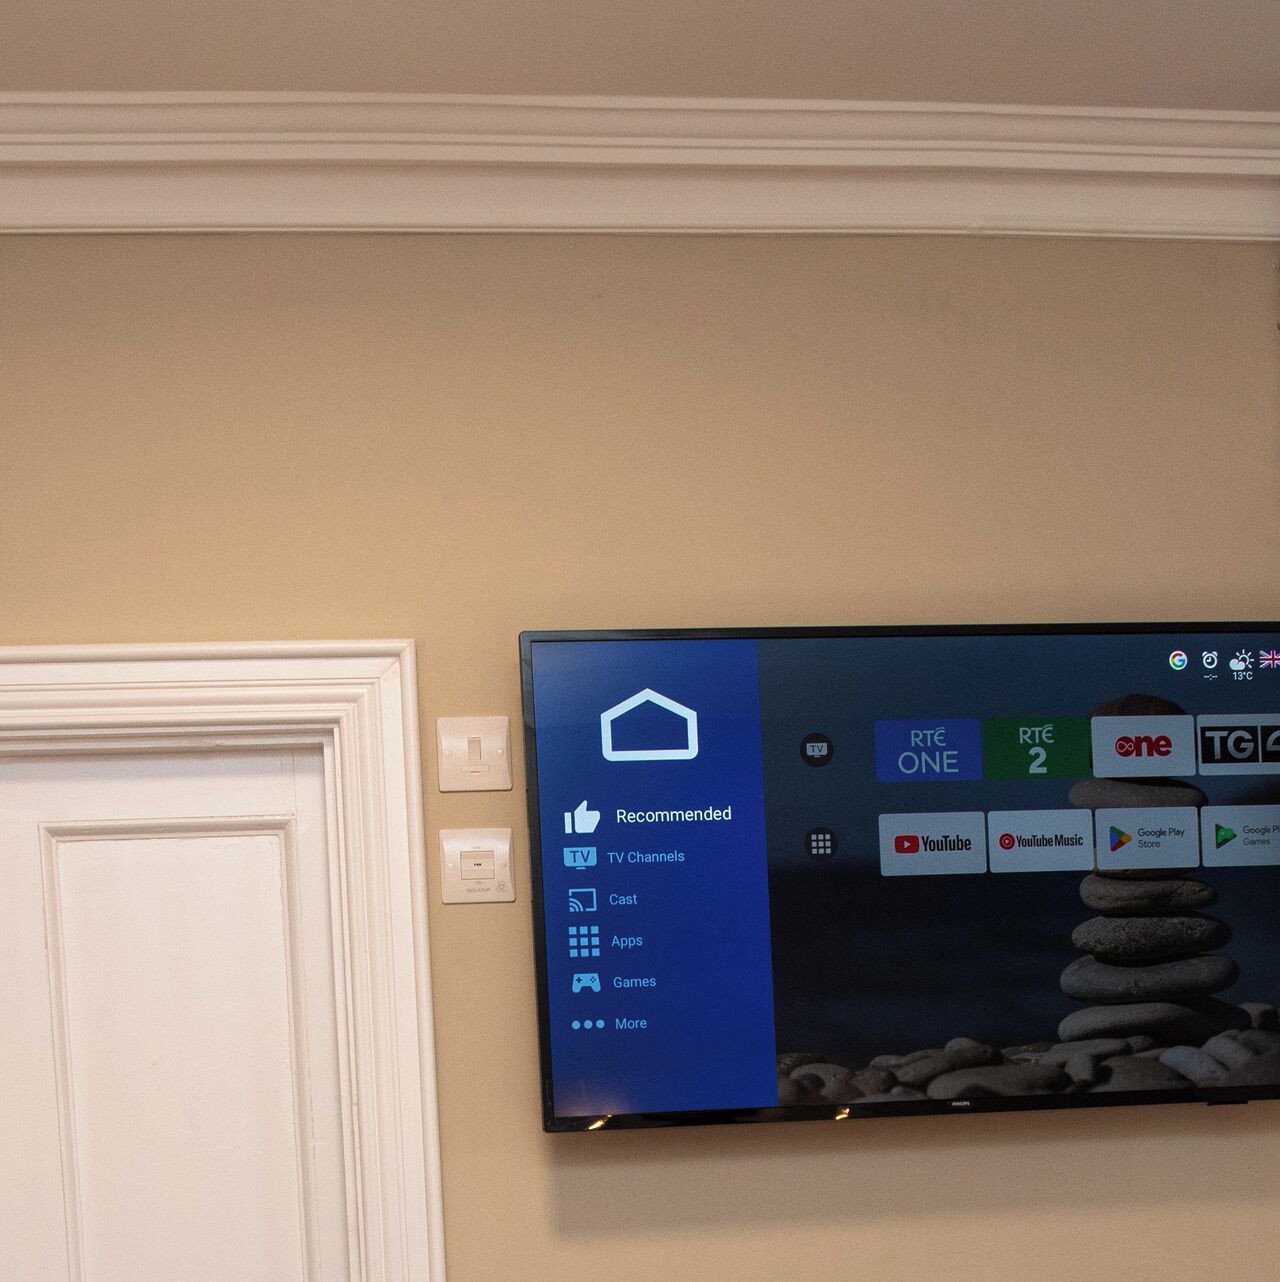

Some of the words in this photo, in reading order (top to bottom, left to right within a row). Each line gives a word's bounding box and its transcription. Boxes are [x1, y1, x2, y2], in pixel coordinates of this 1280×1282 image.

[1232, 671, 1253, 681] 13°C
[1115, 735, 1173, 758] one
[898, 751, 959, 774] ONE
[1028, 746, 1048, 774] 2
[616, 805, 732, 824] Recommended
[1137, 828, 1167, 838] Google
[1168, 827, 1185, 837] Play
[1243, 825, 1271, 835] Google
[921, 835, 972, 852] YouTube
[1016, 834, 1054, 848] YouTube
[1055, 833, 1084, 847] Music
[1138, 840, 1161, 849] Store
[607, 852, 624, 863] TV
[627, 850, 685, 863] Channels
[609, 893, 638, 905] Cast
[611, 936, 643, 949] Apps
[613, 976, 657, 988] Games
[615, 1018, 647, 1030] More
